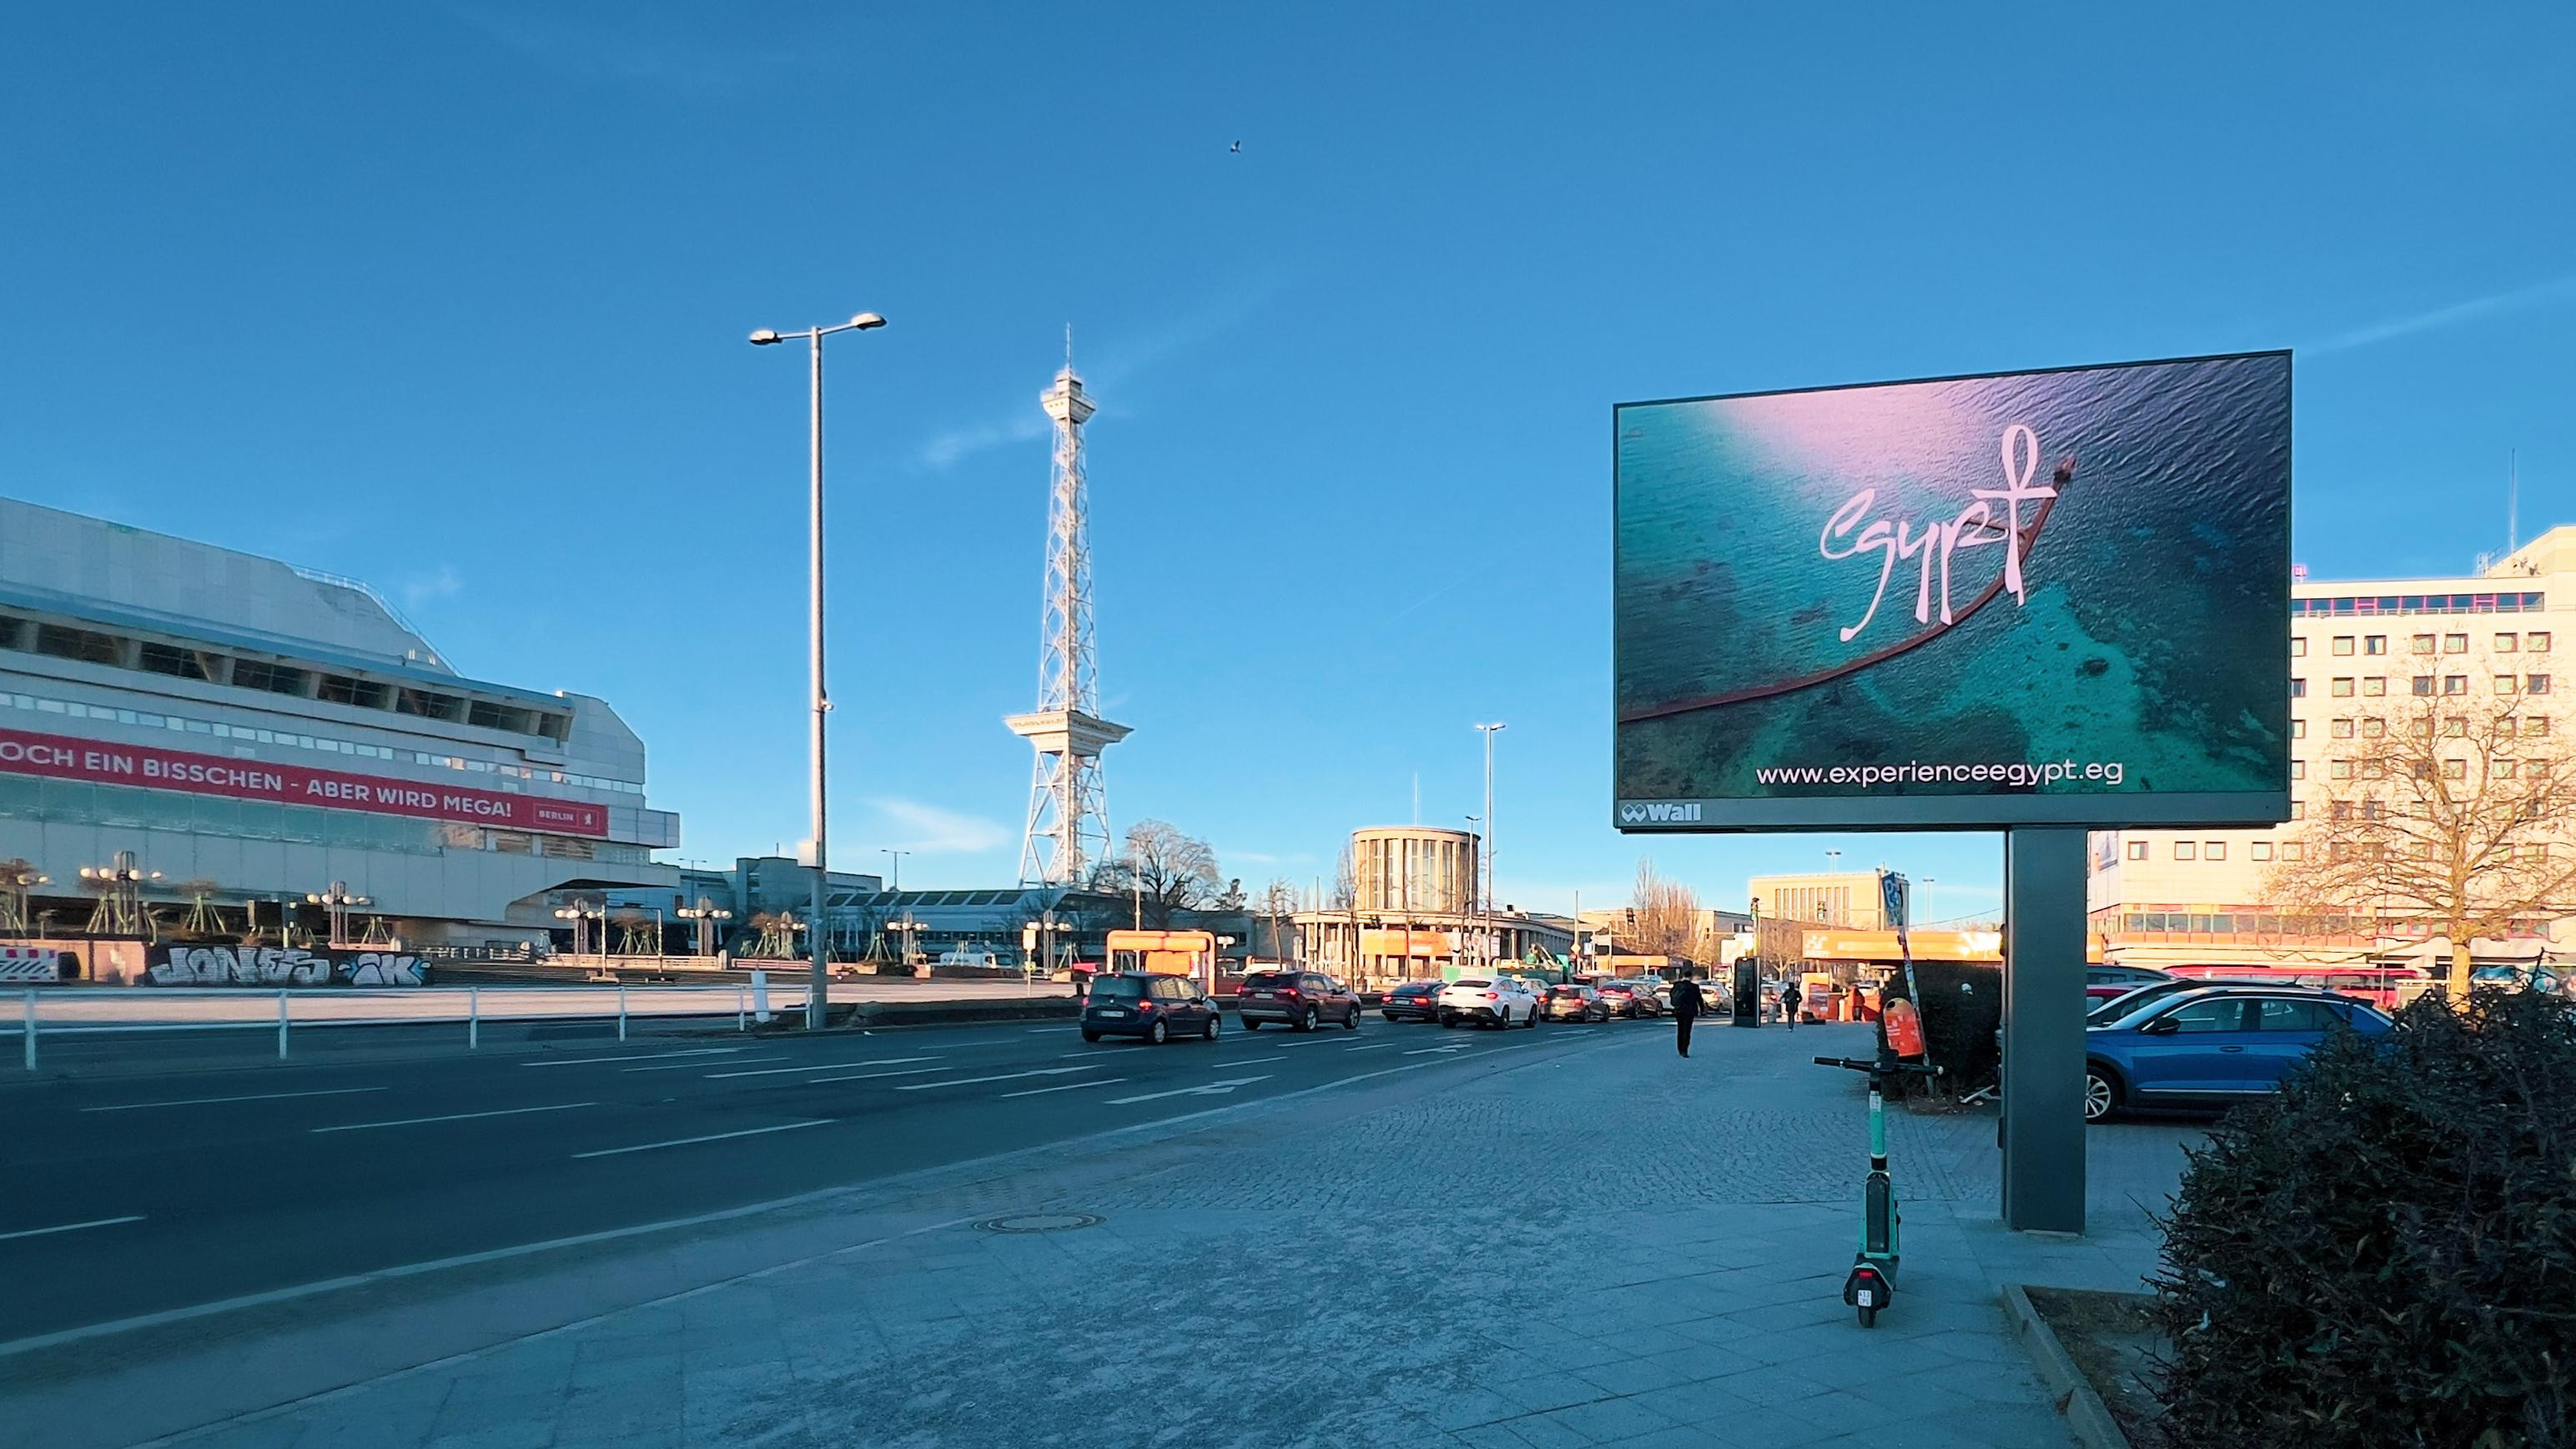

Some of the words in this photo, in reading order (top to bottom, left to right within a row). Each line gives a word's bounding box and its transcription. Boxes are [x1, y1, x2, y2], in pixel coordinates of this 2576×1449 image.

[0, 742, 73, 767] OCH
[85, 751, 133, 775] EIN
[143, 758, 282, 792] BISSCHEN
[306, 779, 370, 802] ABER
[376, 787, 437, 809] WIRD
[443, 795, 512, 818] MEGA!
[1755, 758, 2124, 787] www.experienceegypt.eg
[538, 809, 575, 823] BERLIN
[1646, 803, 1702, 822] Wall
